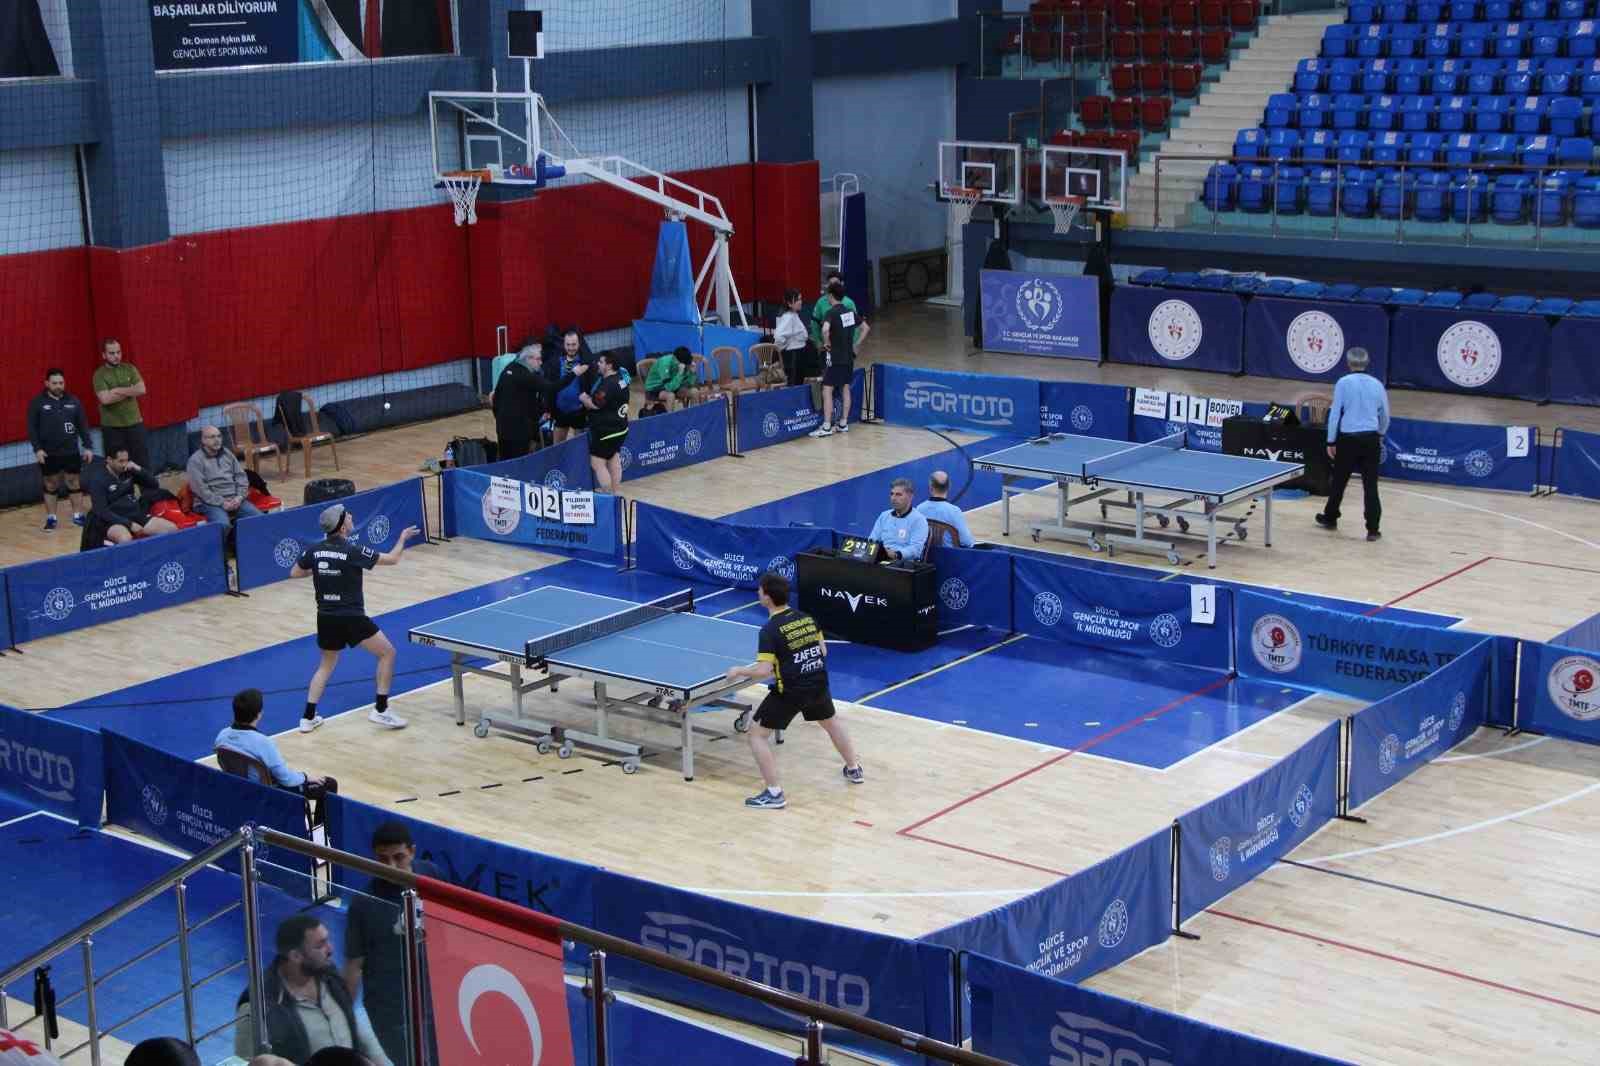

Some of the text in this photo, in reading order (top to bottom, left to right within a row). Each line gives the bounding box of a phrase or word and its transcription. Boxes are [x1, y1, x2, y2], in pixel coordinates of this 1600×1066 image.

[153, 0, 278, 18] BAŞARILAR DİLİYORUM
[207, 47, 217, 56] VE
[903, 388, 1014, 417] SPORTOTO
[1174, 400, 1181, 417] 1
[1193, 403, 1200, 420] 1
[1515, 435, 1525, 450] 2
[1243, 447, 1304, 462] NAVEK
[528, 491, 539, 511] 0
[547, 494, 557, 513] 2
[843, 540, 855, 552] 2
[821, 587, 888, 613] NAVEK
[1200, 596, 1209, 614] 1
[1307, 632, 1375, 659] TÜRKİYE
[1379, 646, 1430, 667] MASA
[1053, 945, 1065, 960] VE
[1066, 935, 1090, 954] SPOR
